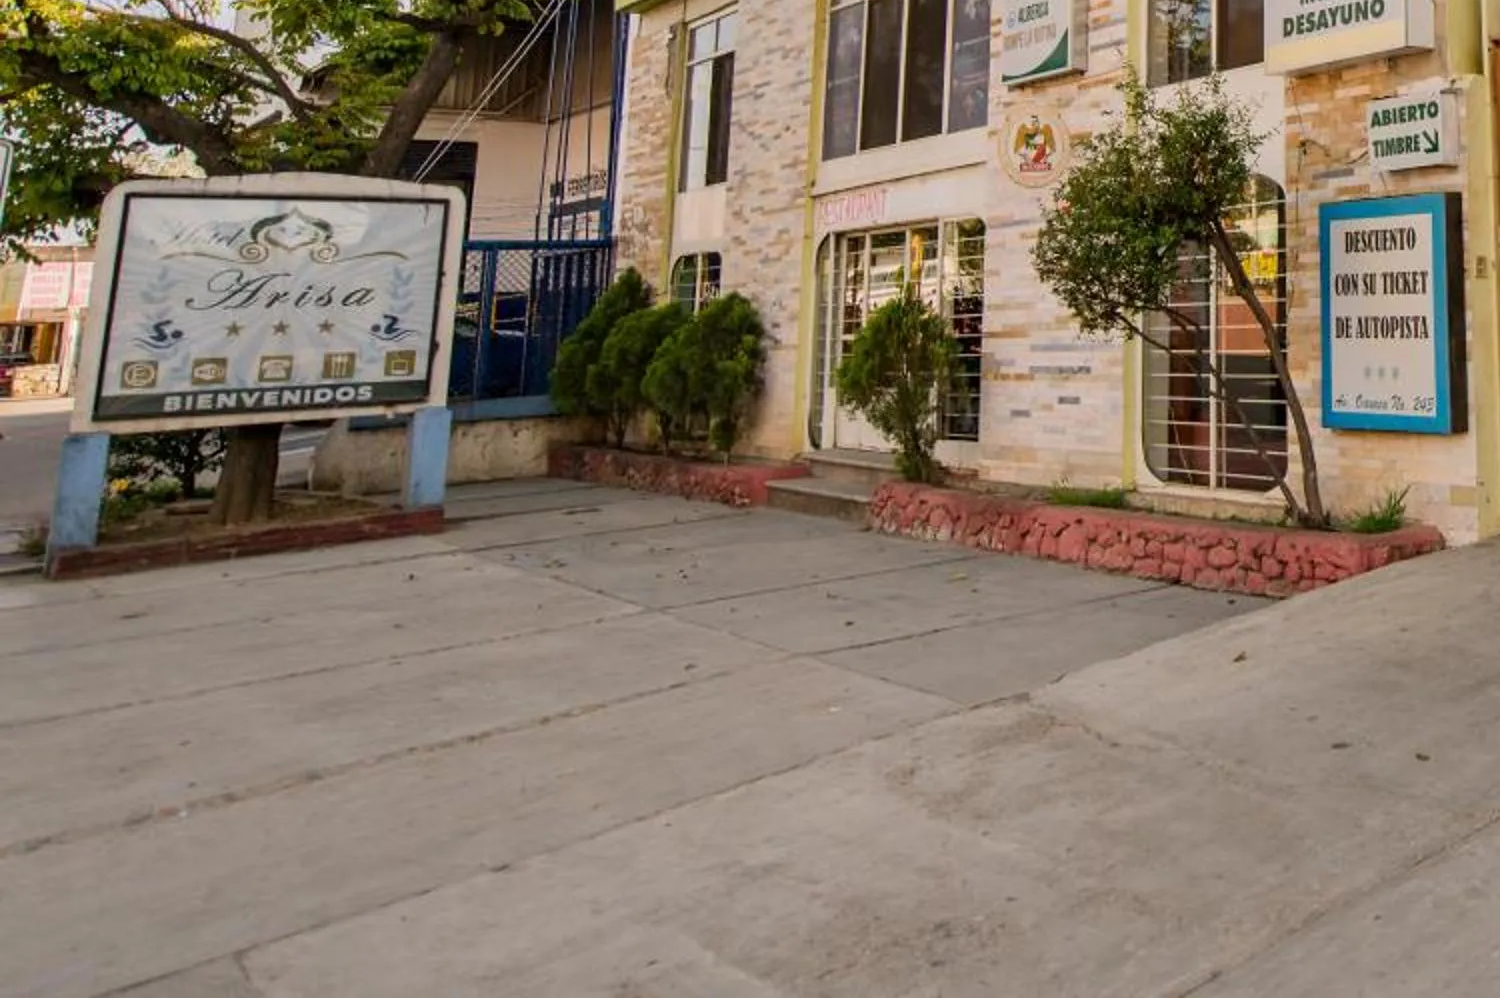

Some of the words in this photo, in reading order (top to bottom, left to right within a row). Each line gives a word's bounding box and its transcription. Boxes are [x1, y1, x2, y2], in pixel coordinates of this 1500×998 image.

[1370, 100, 1440, 129] ABIERTO
[1371, 133, 1421, 159] TIMBRE
[1344, 226, 1417, 254] DESCUENTO
[185, 268, 377, 311] Arisa
[1334, 273, 1359, 297] CON
[1362, 272, 1376, 296] SU
[1381, 271, 1429, 296] TICKET
[1335, 317, 1352, 339] DE
[1355, 315, 1429, 340] AUTOPISTA
[163, 385, 373, 413] BIENVENIDOS
